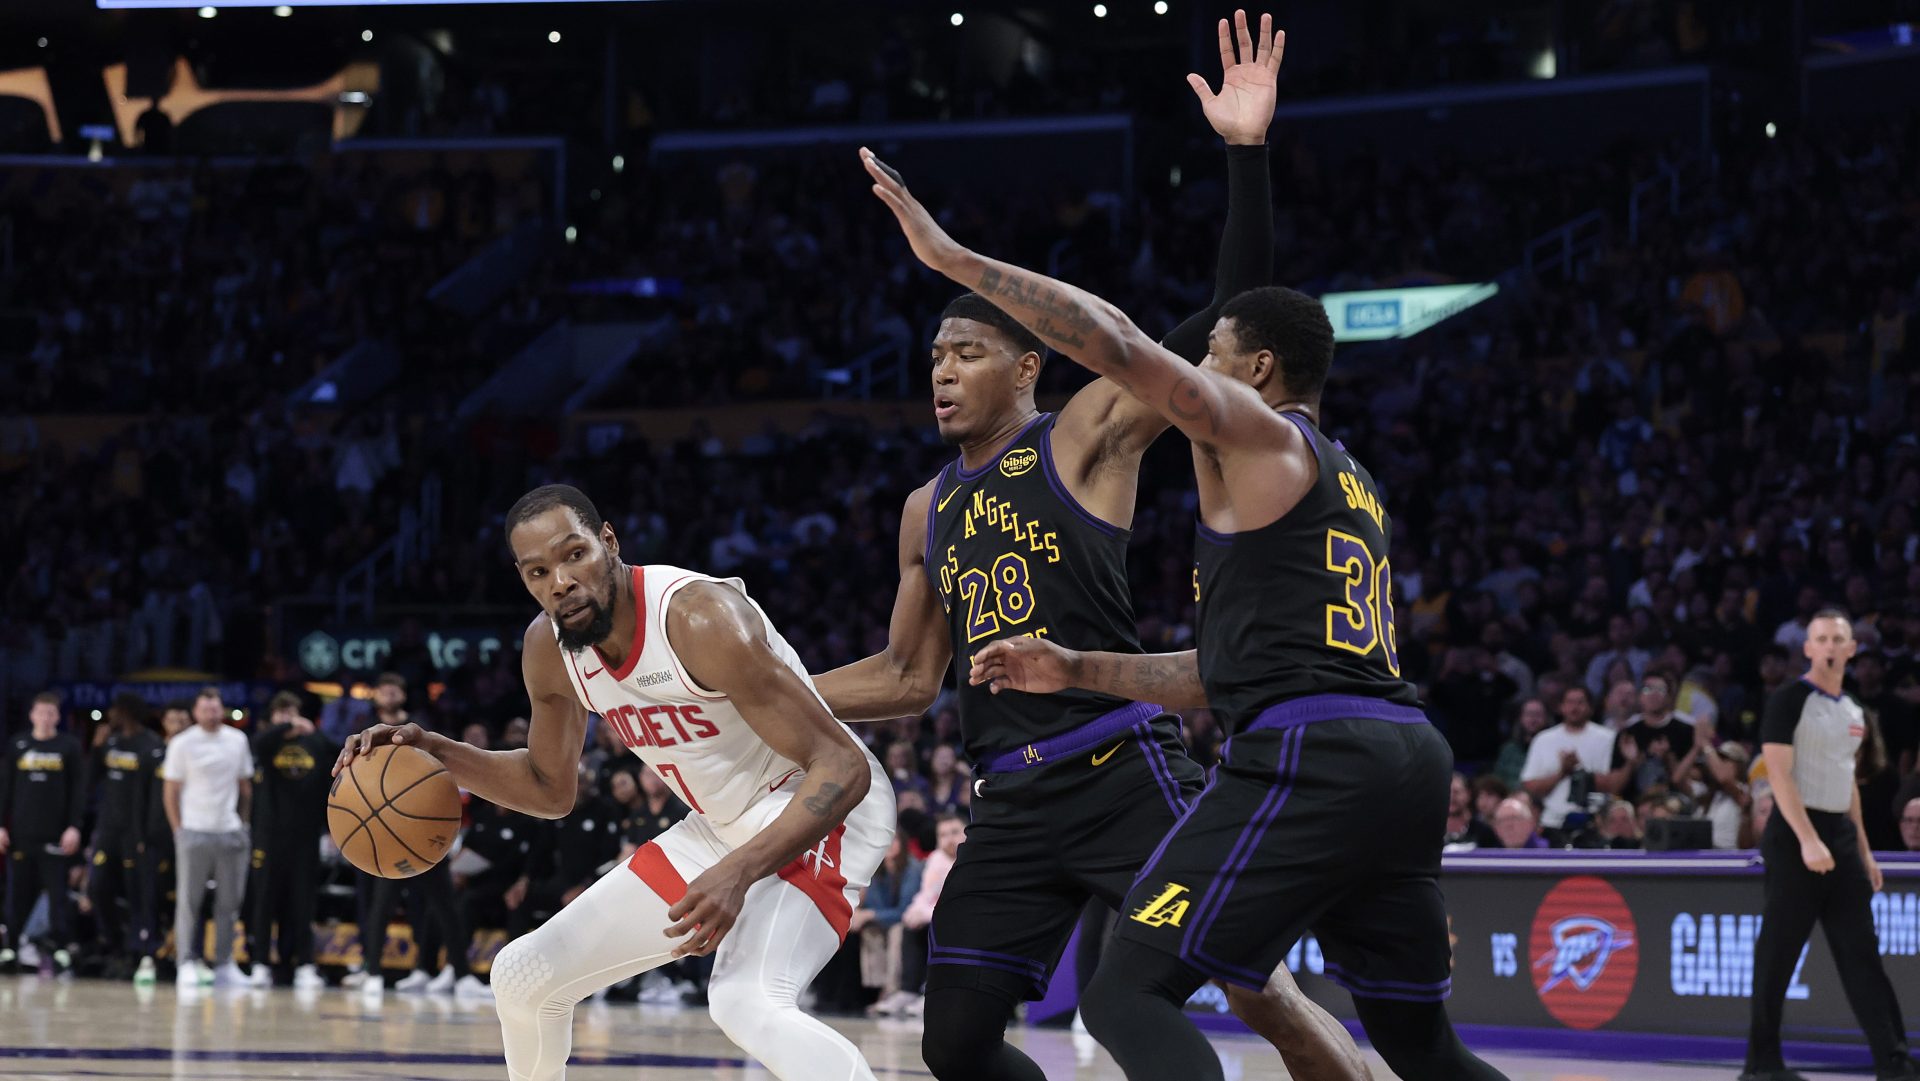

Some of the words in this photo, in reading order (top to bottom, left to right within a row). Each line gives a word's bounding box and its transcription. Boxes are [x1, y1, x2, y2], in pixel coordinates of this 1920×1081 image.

[1003, 455, 1035, 468] bibigo
[964, 489, 1061, 563] ANGELES
[958, 552, 1036, 644] 28
[636, 670, 671, 683] MEMORIAL
[638, 674, 673, 688] HERMANN
[602, 704, 720, 748] OCKETS
[1023, 745, 1042, 764] LAL
[656, 763, 705, 814] 7
[1130, 882, 1190, 928] LA
[1490, 933, 1517, 976] VS
[1671, 912, 1764, 998] GAM
